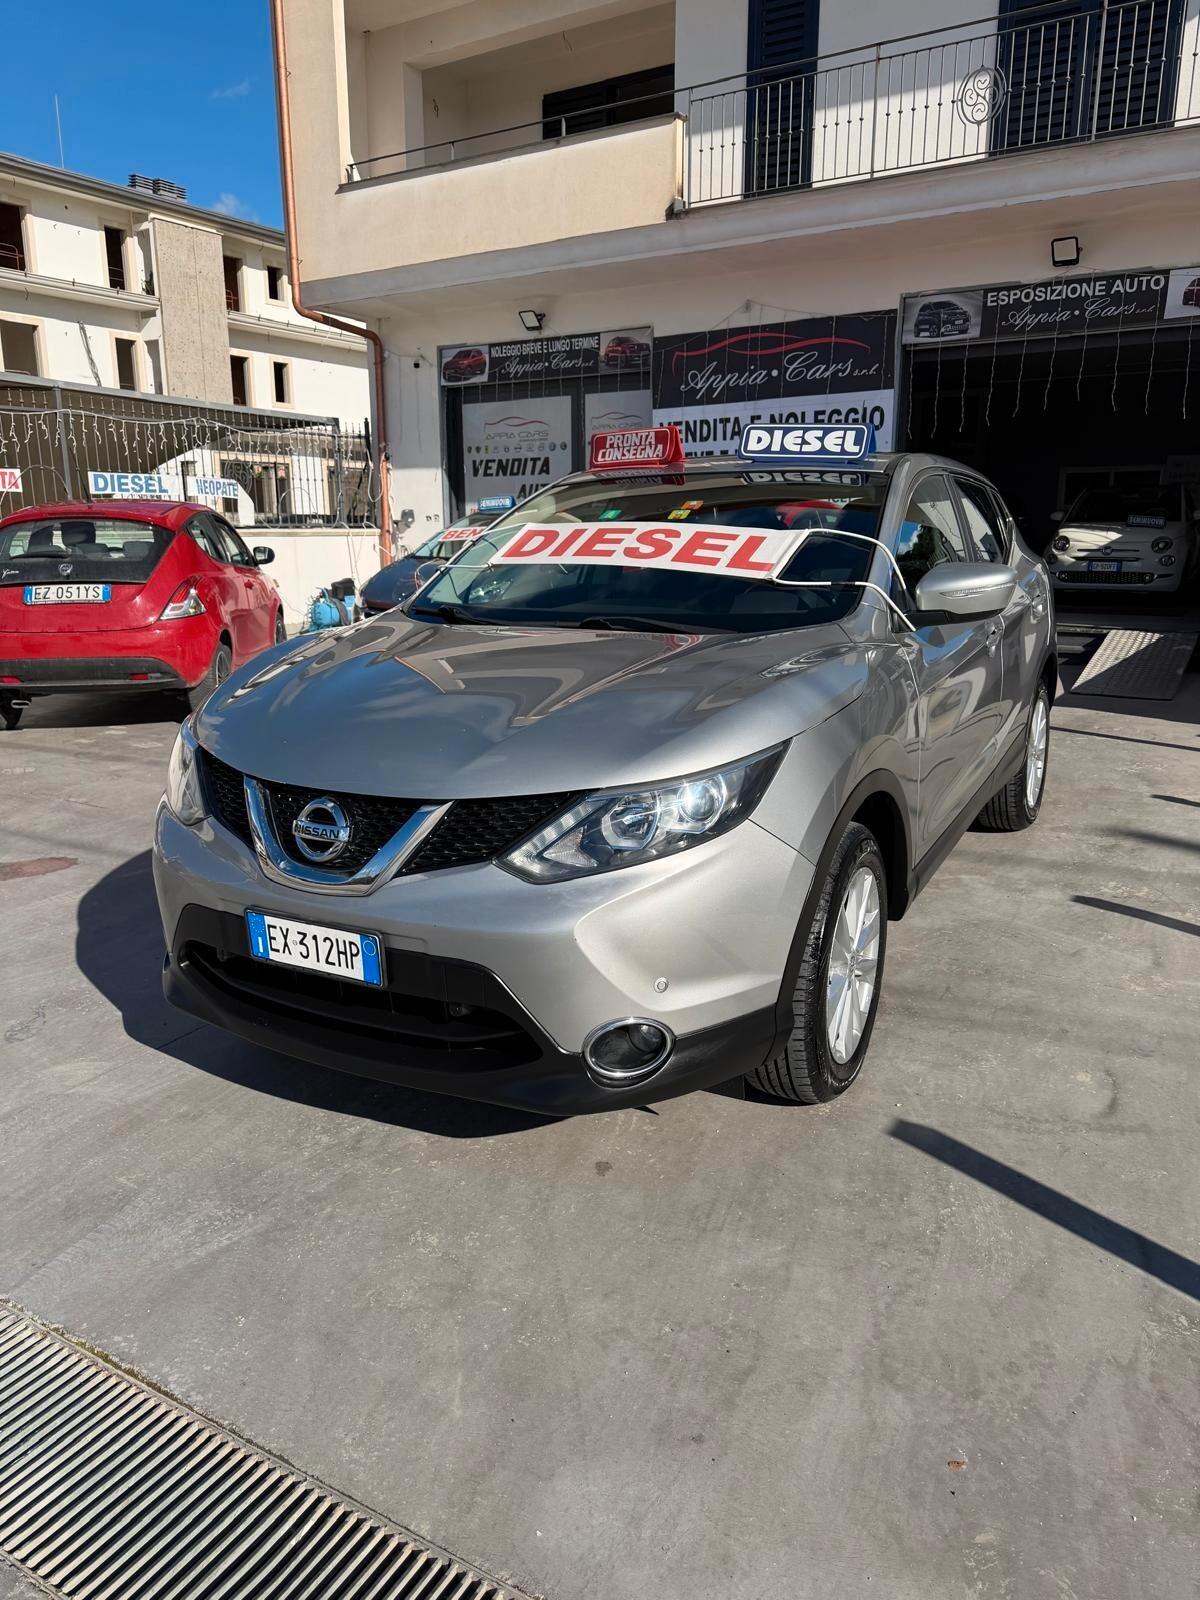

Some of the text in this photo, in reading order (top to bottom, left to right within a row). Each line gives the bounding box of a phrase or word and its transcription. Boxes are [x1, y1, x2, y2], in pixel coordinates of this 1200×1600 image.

[987, 275, 1165, 307] ESPOSIZIONE AUTO
[1001, 304, 1071, 332] Appia
[1083, 298, 1138, 320] Cars
[490, 336, 599, 358] NOLEGGIO BREVE E LUNGO TERMINE
[501, 357, 545, 378] Appia
[549, 353, 582, 370] Cars
[680, 361, 768, 400] Appia
[784, 351, 853, 381] Cars
[486, 433, 516, 441] APPIA
[519, 430, 549, 438] CARS
[605, 431, 656, 449] PRONTA
[747, 429, 860, 453] DIESEL
[597, 443, 663, 461] CONSEGNA
[472, 457, 550, 477] VENDITA
[92, 473, 169, 494] DIESEL
[501, 528, 776, 572] DIESEL
[295, 823, 340, 839] NISSAN
